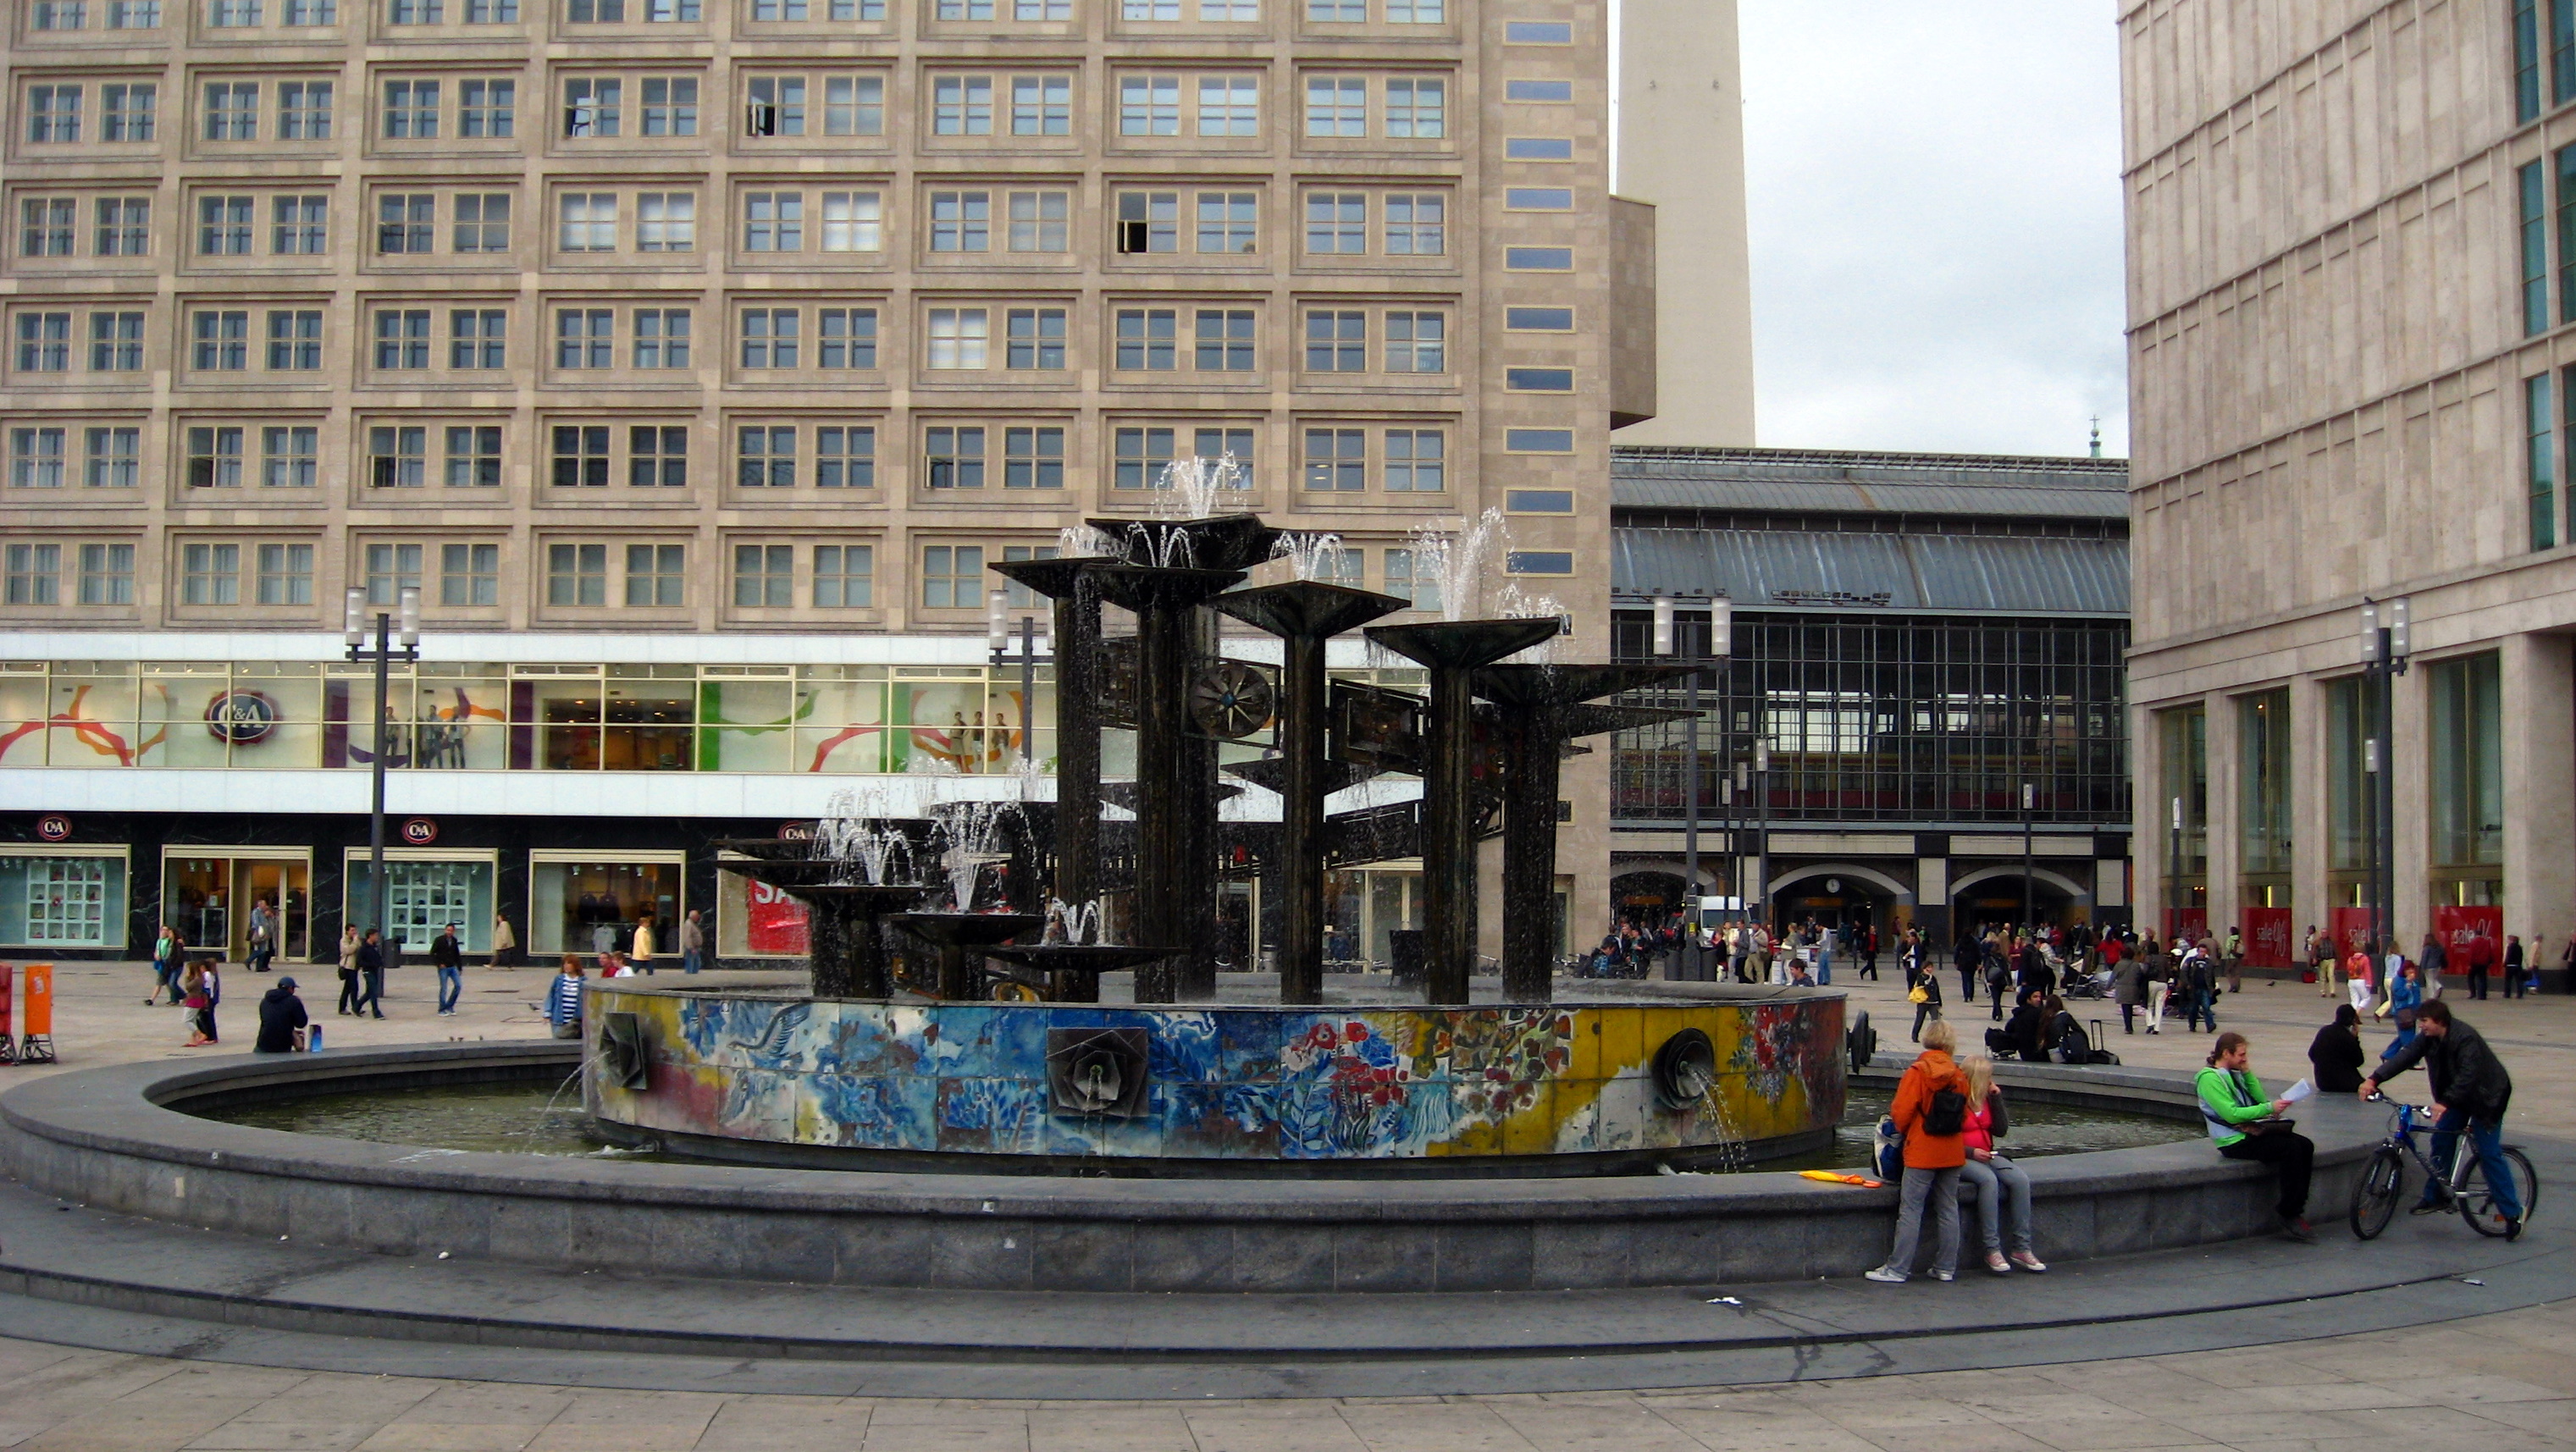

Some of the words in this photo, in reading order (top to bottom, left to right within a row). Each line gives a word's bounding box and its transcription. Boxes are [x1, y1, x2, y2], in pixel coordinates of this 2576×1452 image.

[218, 704, 265, 728] C&A
[44, 821, 65, 833] C&A
[408, 824, 430, 836] C&A
[754, 881, 797, 904] SA
